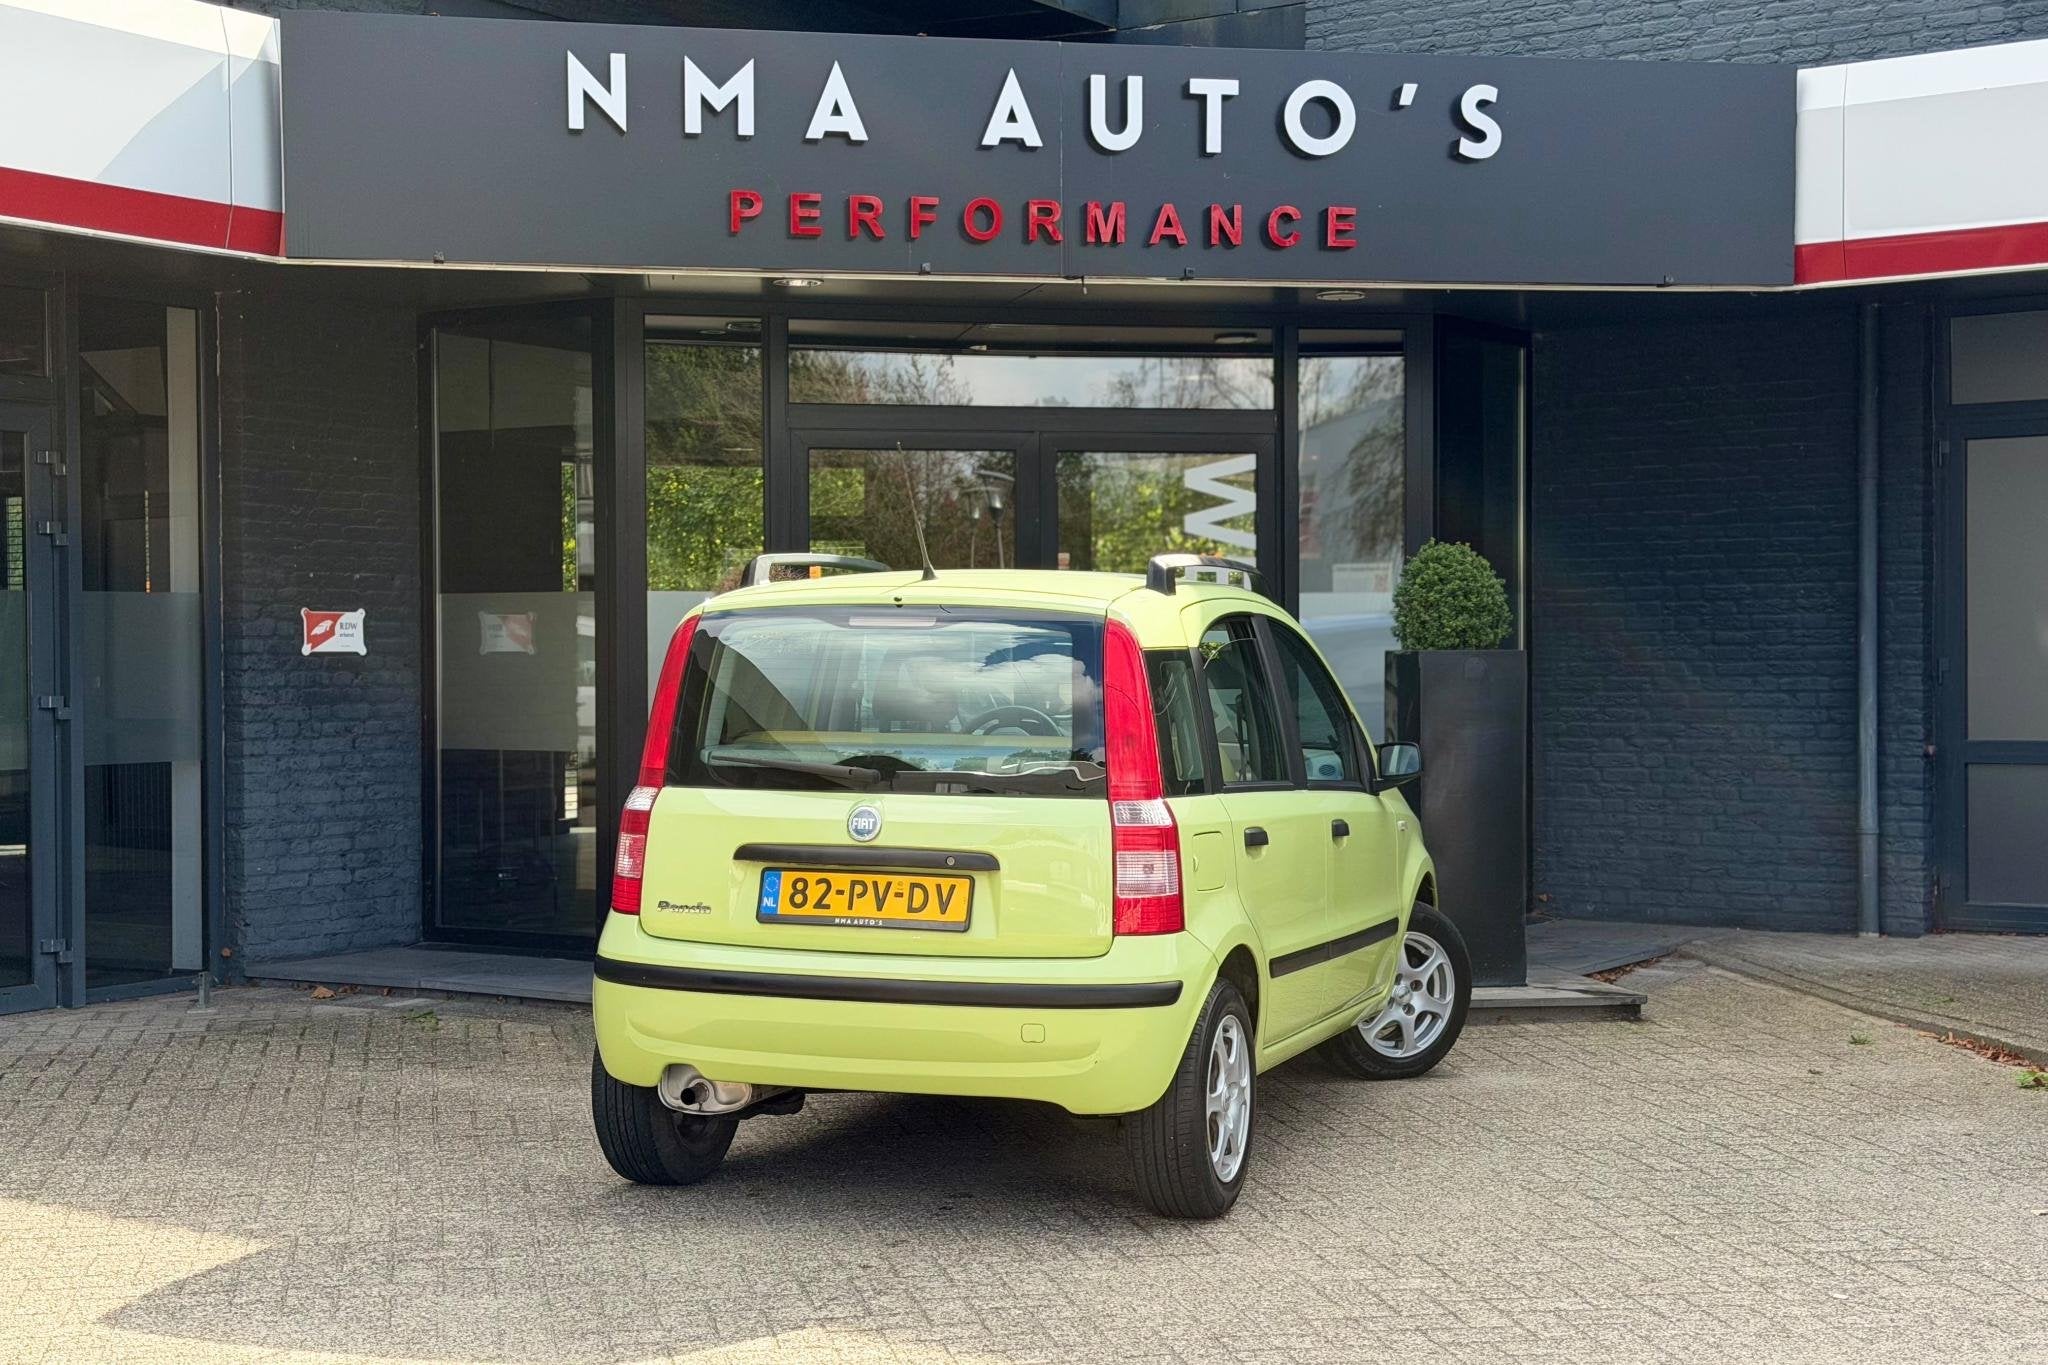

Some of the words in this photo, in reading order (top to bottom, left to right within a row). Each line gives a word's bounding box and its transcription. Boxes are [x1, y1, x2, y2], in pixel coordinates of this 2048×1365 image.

[567, 49, 869, 141] NMA
[981, 66, 1502, 160] AUTO'S
[729, 189, 1357, 248] PERFORMANCE
[339, 622, 358, 630] RDW
[852, 817, 876, 830] FIAT
[763, 896, 777, 908] NL
[788, 877, 956, 915] 82-PV-DV
[834, 917, 851, 925] NMA
